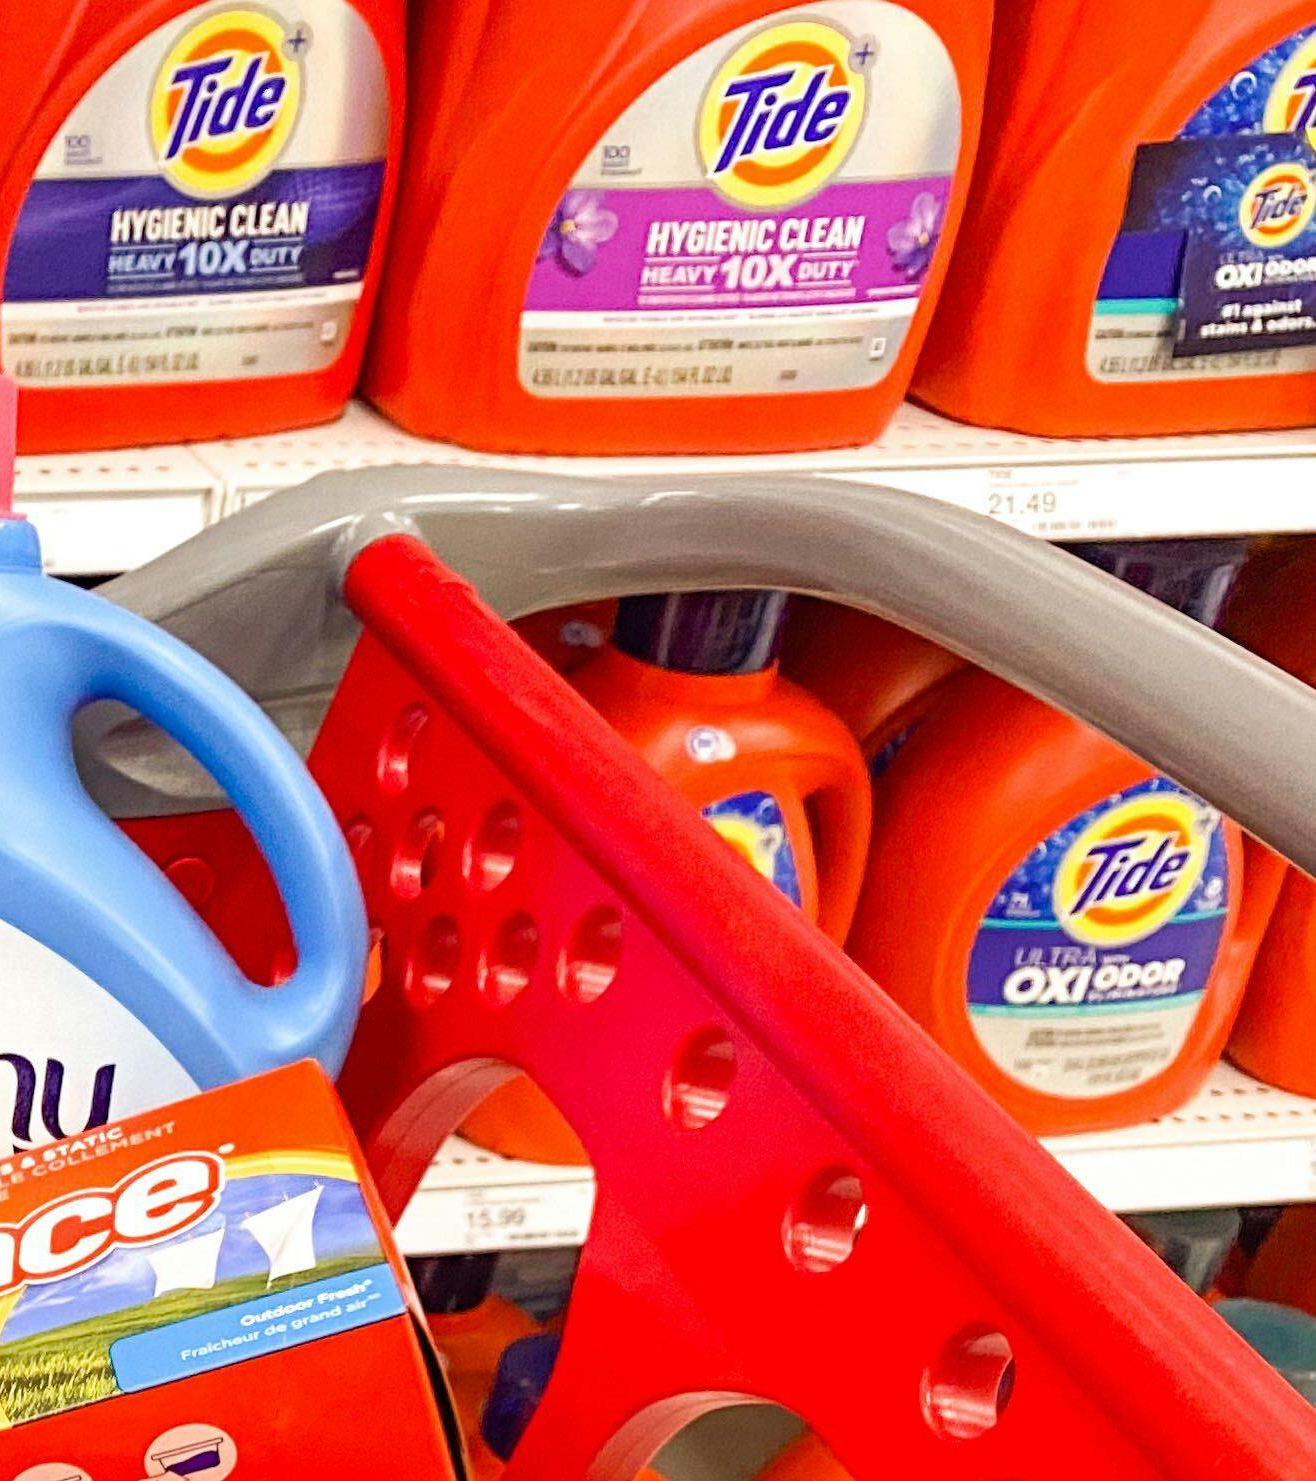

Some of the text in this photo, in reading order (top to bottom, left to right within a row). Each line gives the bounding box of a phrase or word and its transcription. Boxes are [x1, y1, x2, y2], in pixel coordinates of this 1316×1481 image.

[167, 55, 288, 160] Tide
[715, 69, 851, 174] Tide
[110, 201, 309, 242] HYGIENIC CLEAN
[1252, 184, 1308, 229] Tide
[646, 215, 865, 256] HYGIENIC CLEAN
[107, 240, 303, 276] HEAVY 10X DUTY
[641, 253, 854, 290] HEAVY 10X DUTY
[1216, 261, 1263, 289] OXI
[1200, 323, 1247, 338] stains
[1252, 318, 1263, 333] &
[988, 492, 1057, 514] 21.49
[1070, 835, 1190, 915] Tide
[1004, 959, 1186, 1004] OXI ODOR
[0, 1169, 25, 1184] LE
[31, 1121, 175, 1176] COLLEMENT
[22, 1155, 36, 1169] &
[43, 1128, 123, 1161] STATIC
[240, 1281, 367, 1326] Outdoor Fresh
